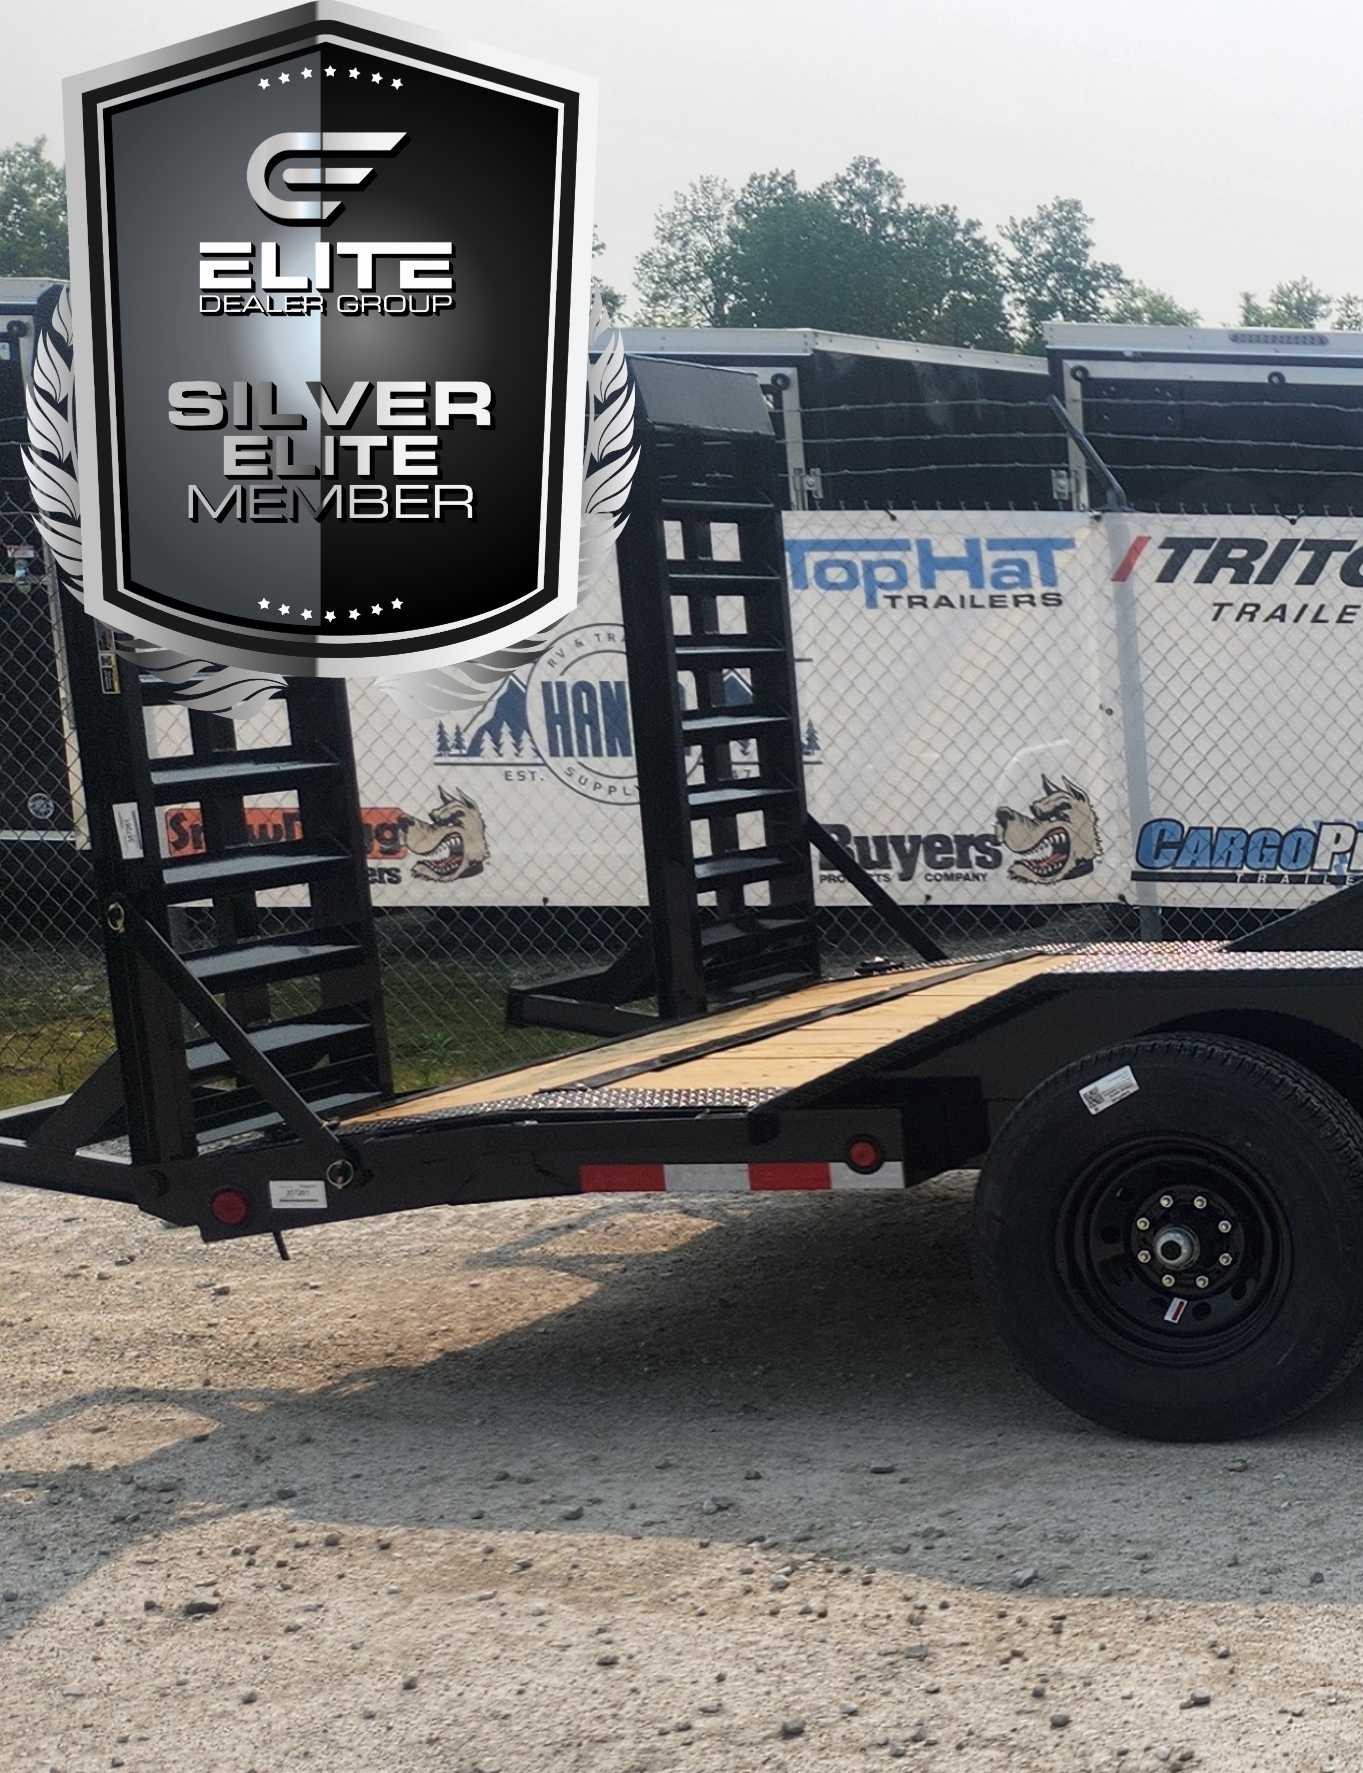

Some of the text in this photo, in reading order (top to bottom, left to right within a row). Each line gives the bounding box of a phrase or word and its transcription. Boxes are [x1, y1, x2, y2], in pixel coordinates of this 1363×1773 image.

[884, 592, 1063, 610] TRAILERS
[547, 648, 567, 669] RV
[541, 680, 634, 758] HAN
[504, 770, 545, 781] EST.
[818, 823, 1004, 882] Buyers
[924, 873, 989, 882] COMPANY
